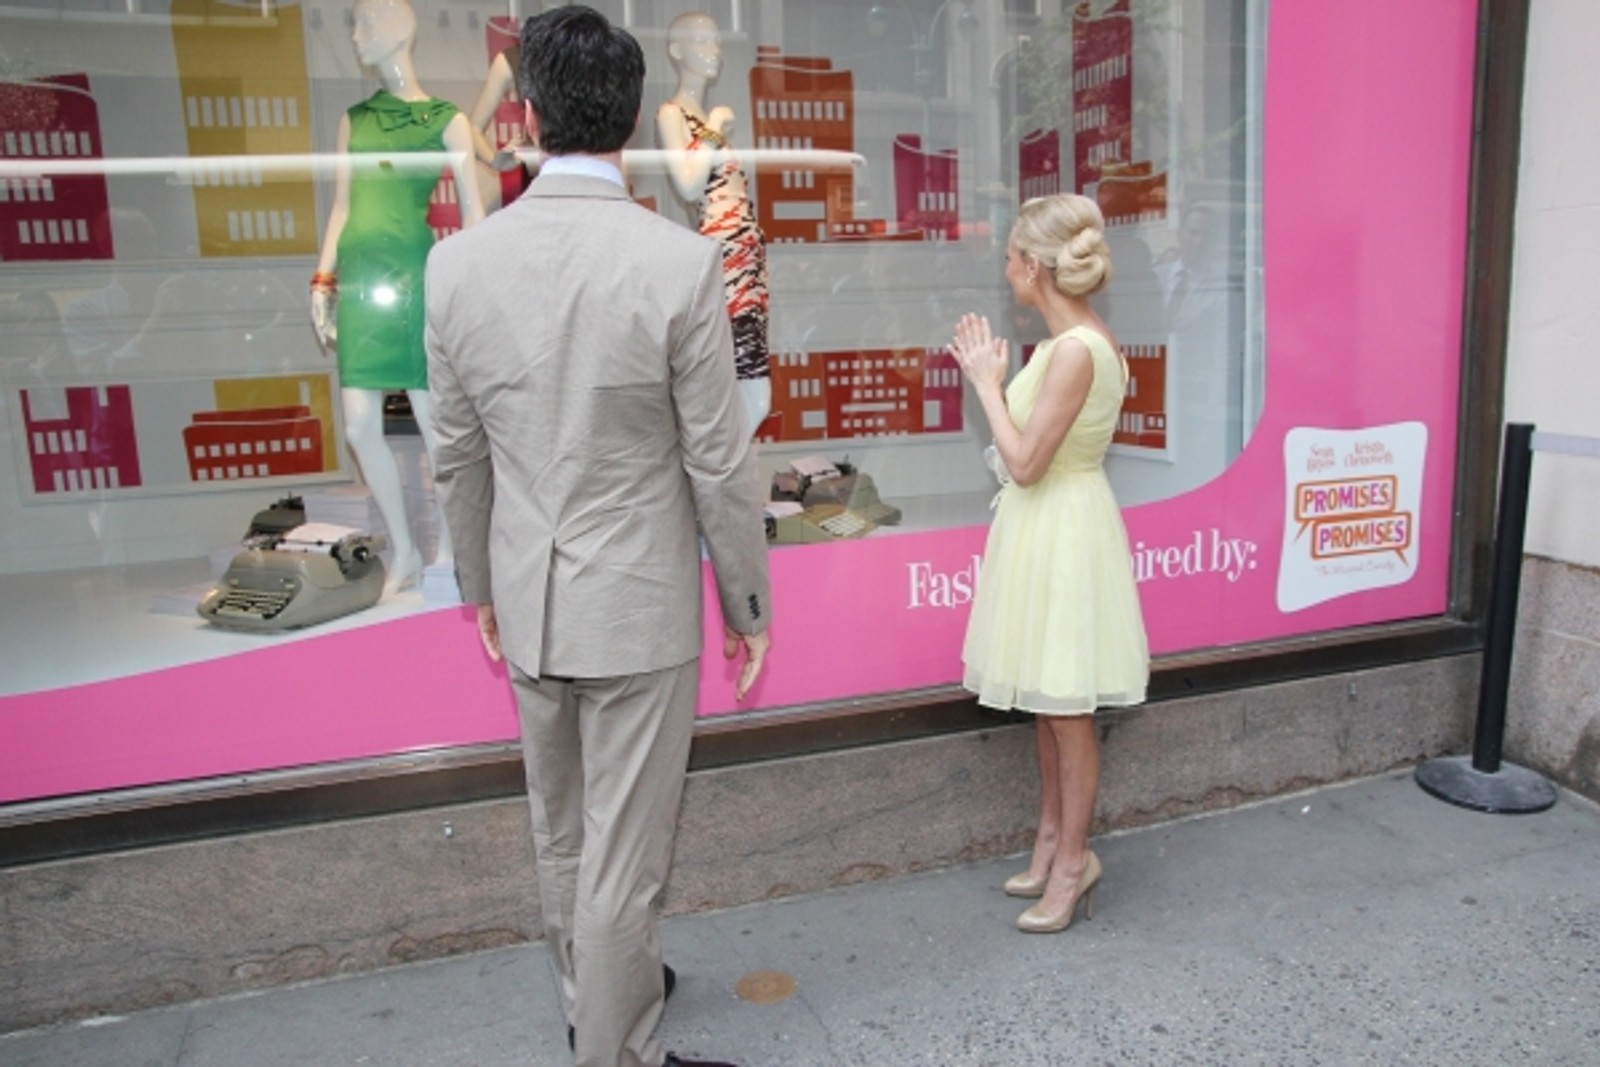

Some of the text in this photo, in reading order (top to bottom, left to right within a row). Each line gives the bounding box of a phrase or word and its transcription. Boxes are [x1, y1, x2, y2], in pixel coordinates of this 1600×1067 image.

[1303, 483, 1389, 513] PROMISES
[1320, 520, 1404, 551] PROMISES
[1131, 530, 1203, 582] ired
[1208, 528, 1257, 582] by:
